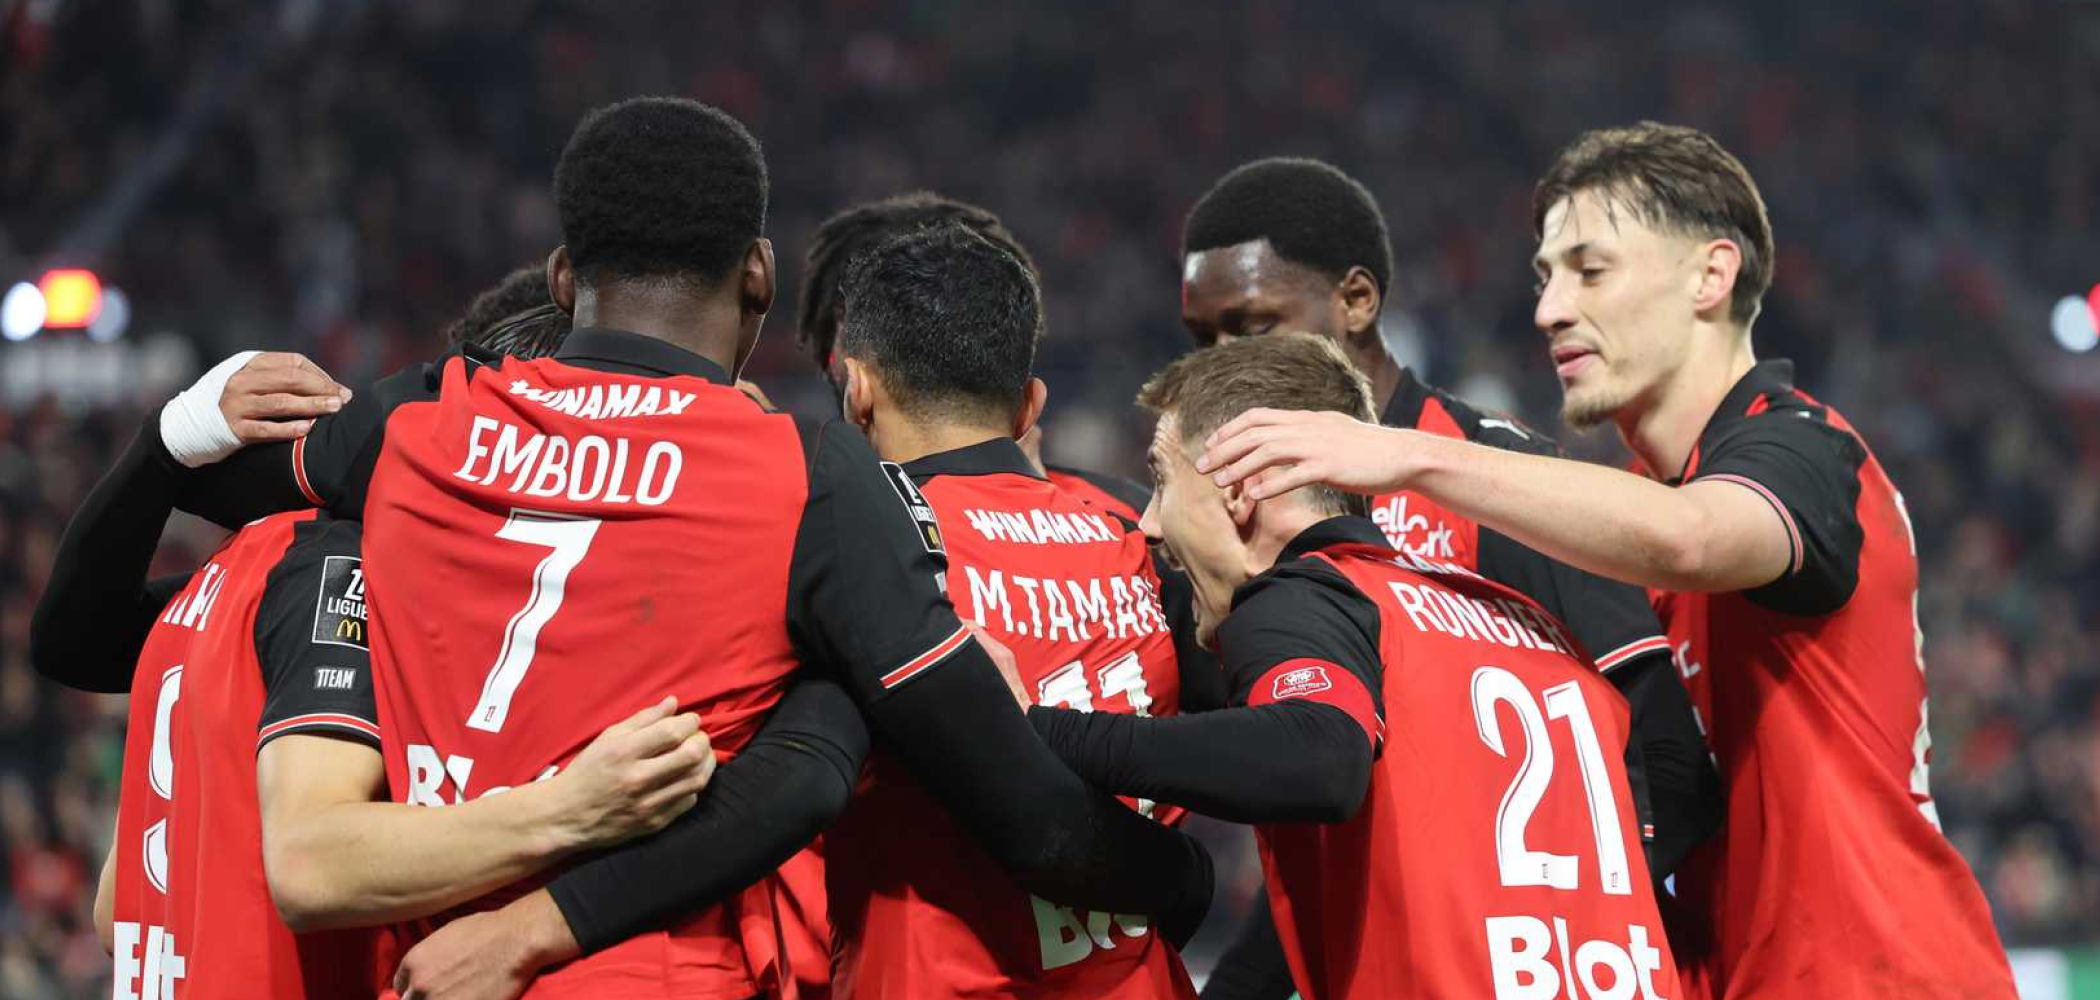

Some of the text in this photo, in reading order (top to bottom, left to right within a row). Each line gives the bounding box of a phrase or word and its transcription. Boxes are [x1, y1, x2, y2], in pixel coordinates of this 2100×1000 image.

[453, 415, 683, 506] EMBOLO
[964, 508, 1121, 545] WINAMAX
[465, 507, 603, 733] 7
[1470, 665, 1633, 896] 21
[1485, 915, 1668, 1000] Blot
